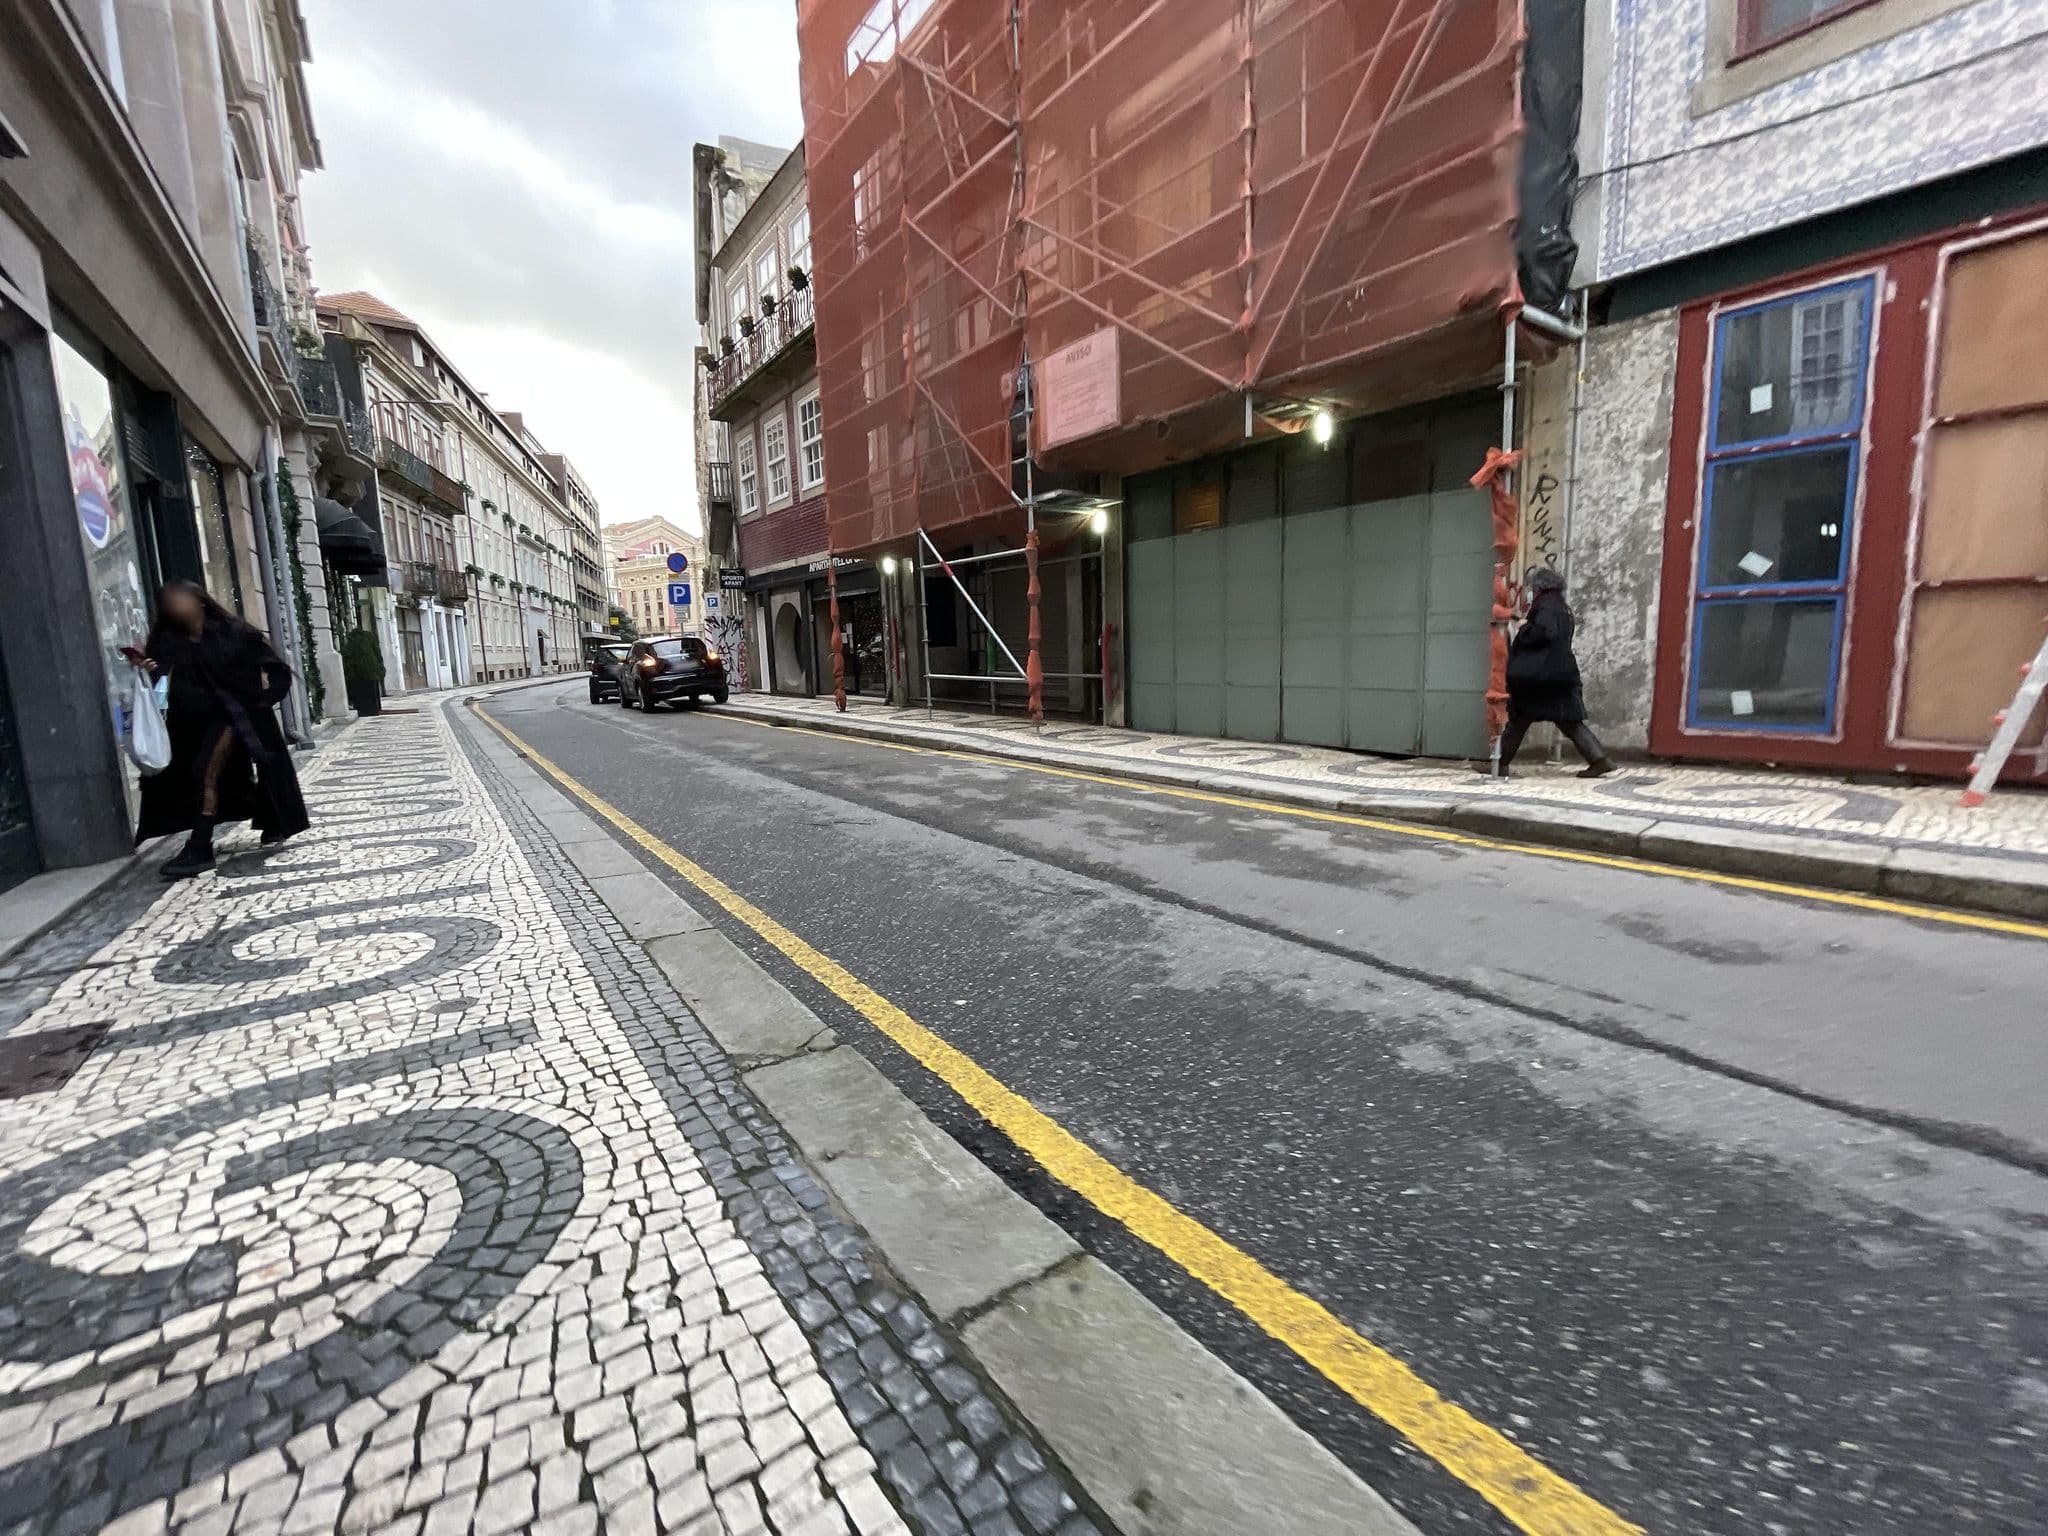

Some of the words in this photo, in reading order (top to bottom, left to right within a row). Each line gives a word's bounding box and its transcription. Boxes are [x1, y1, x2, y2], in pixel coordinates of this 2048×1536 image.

[1065, 343, 1092, 365] AVISO
[673, 586, 686, 603] P
[709, 598, 716, 607] P
